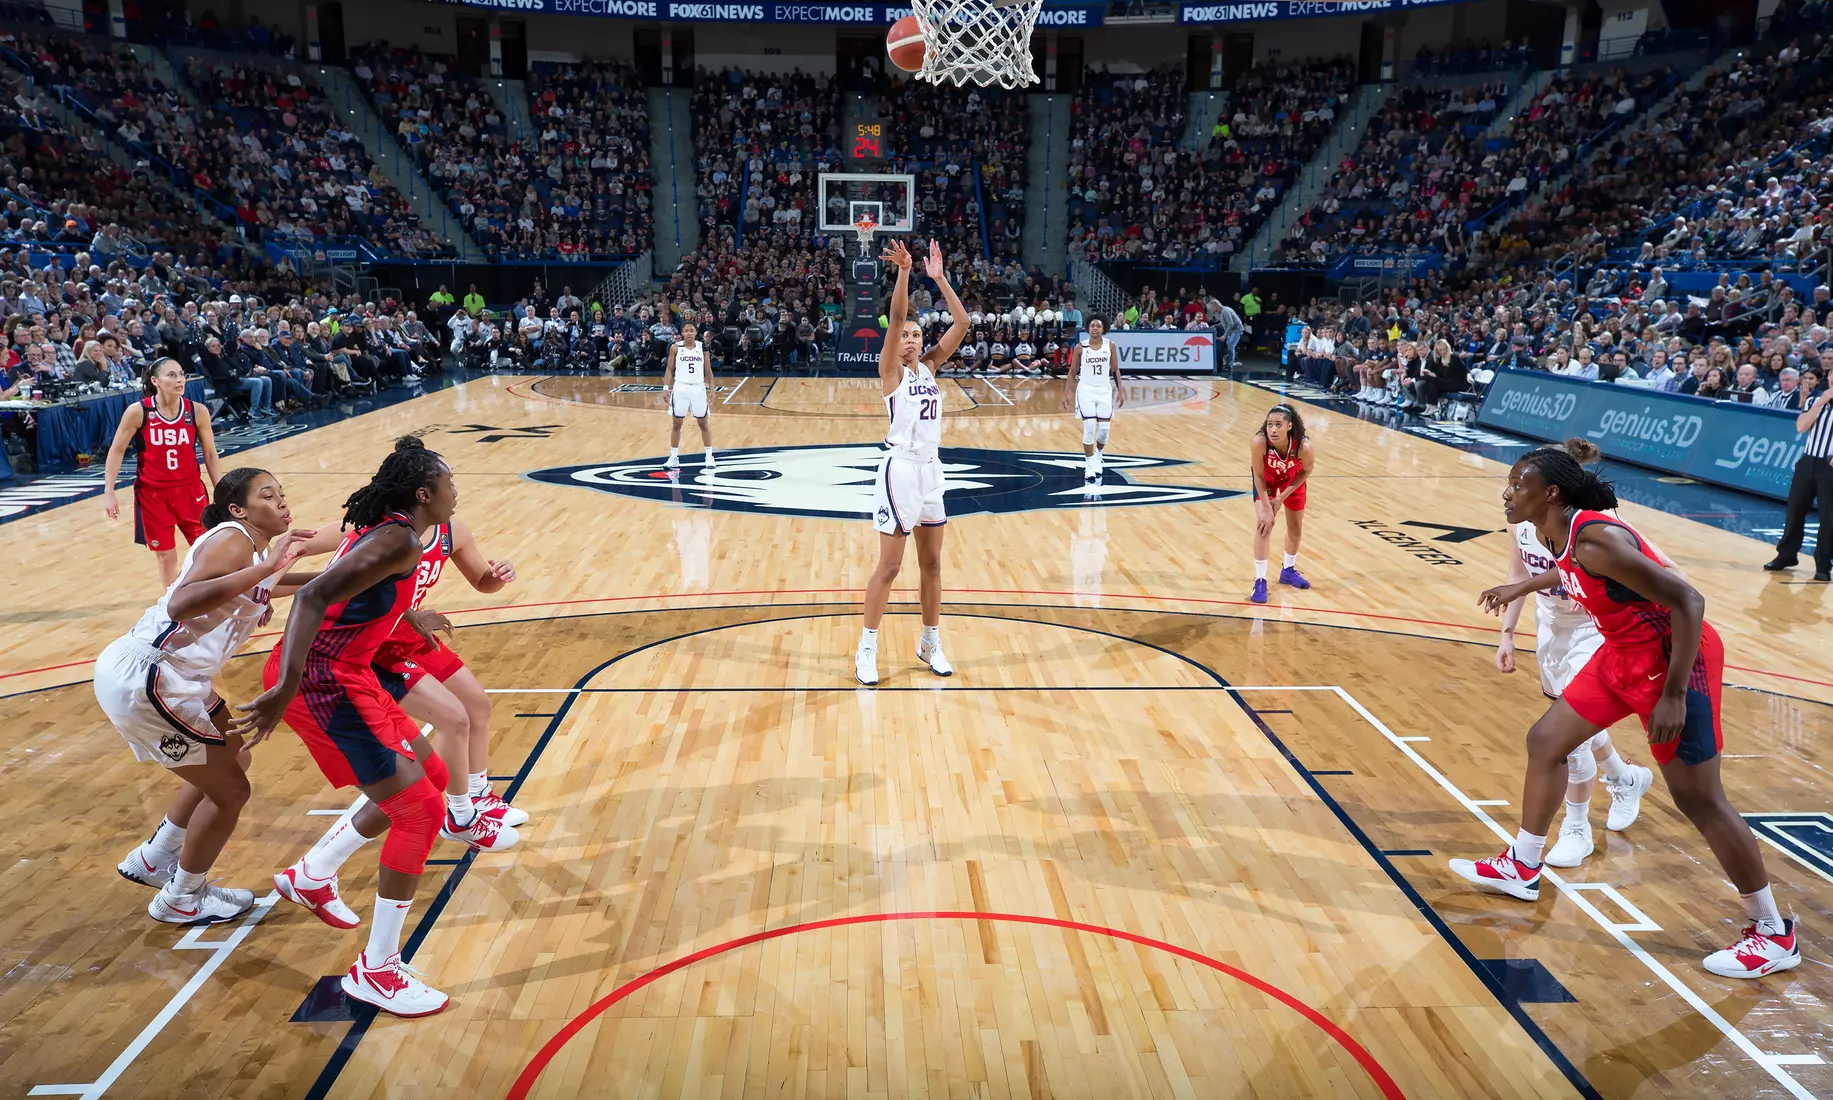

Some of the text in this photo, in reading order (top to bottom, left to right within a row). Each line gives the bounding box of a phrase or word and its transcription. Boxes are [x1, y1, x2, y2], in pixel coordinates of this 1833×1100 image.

[857, 124, 880, 136] 5:48
[854, 137, 879, 158] 24
[1118, 347, 1190, 362] VELERS
[688, 363, 695, 374] 5
[1092, 364, 1102, 375] 13
[920, 399, 938, 420] 20
[1491, 386, 1577, 421] genius3D
[150, 428, 190, 446] USA
[1587, 406, 1703, 448] genius3D
[166, 449, 179, 470] 6
[1268, 459, 1295, 470] USA
[1348, 519, 1463, 565] XL CENTER
[417, 560, 441, 585] SA
